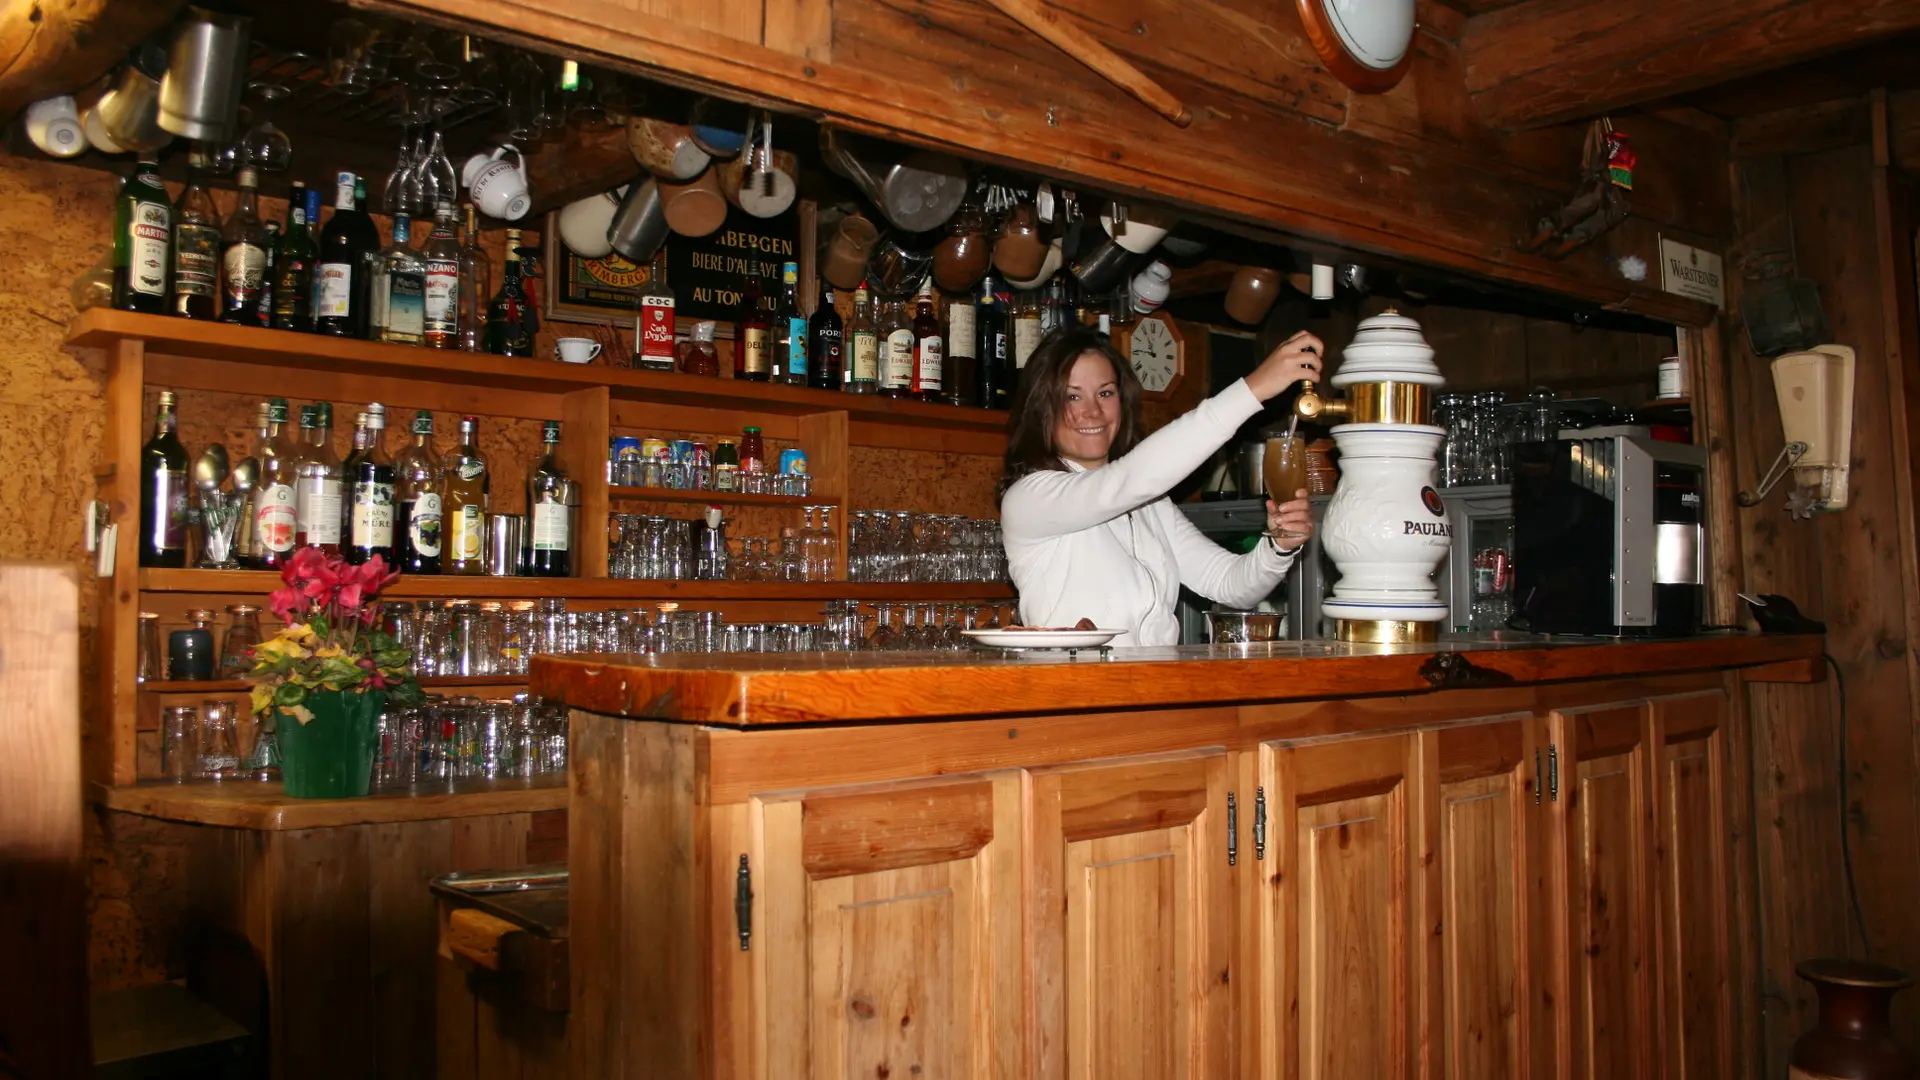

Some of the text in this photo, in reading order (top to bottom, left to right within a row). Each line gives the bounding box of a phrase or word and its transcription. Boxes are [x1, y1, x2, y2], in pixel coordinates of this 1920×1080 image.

[427, 261, 457, 274] NZANO
[692, 251, 779, 280] BIERE D'AAYE
[1669, 258, 1719, 287] WARSTEINER
[692, 286, 778, 312] AU TONU
[1402, 520, 1454, 538] PAULAN
